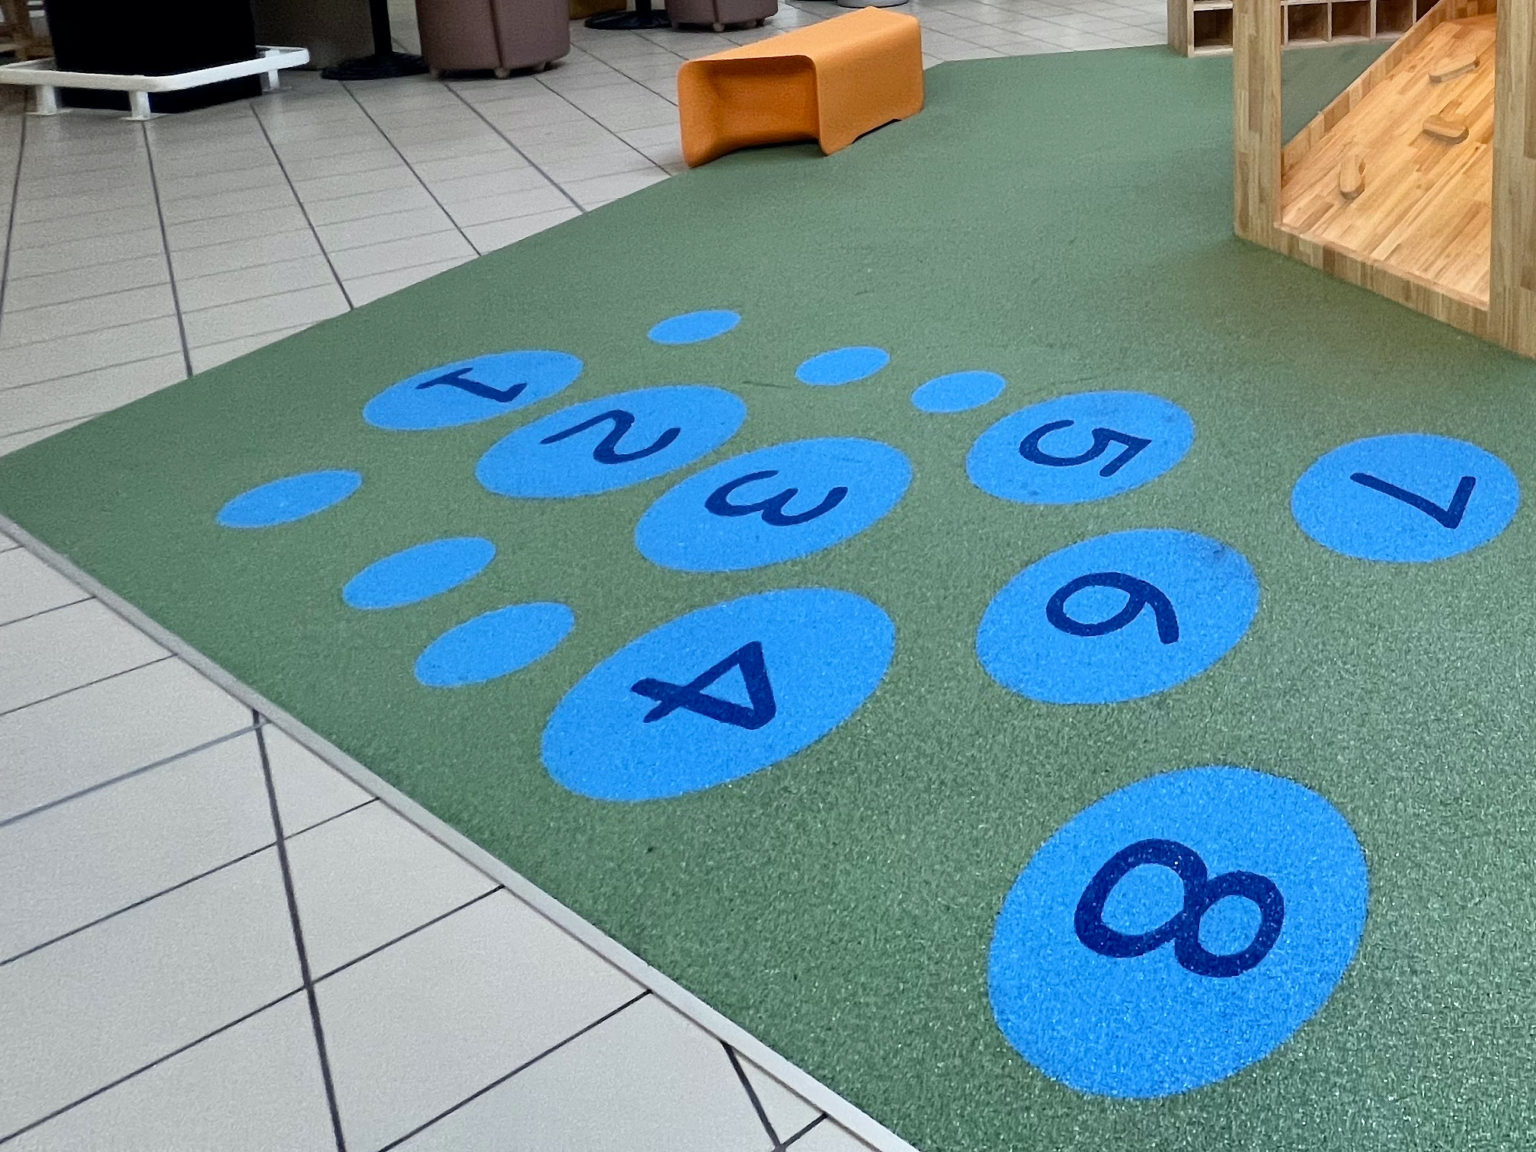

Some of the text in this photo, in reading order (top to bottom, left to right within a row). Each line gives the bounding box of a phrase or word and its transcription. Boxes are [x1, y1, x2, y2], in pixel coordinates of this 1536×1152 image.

[415, 366, 528, 405] 1
[539, 408, 682, 466] 2
[1018, 418, 1153, 479] 5
[703, 469, 849, 528] 3
[1348, 471, 1477, 531] 7
[1045, 570, 1180, 646] 6
[630, 641, 777, 732] 4
[1073, 838, 1286, 980] 8
